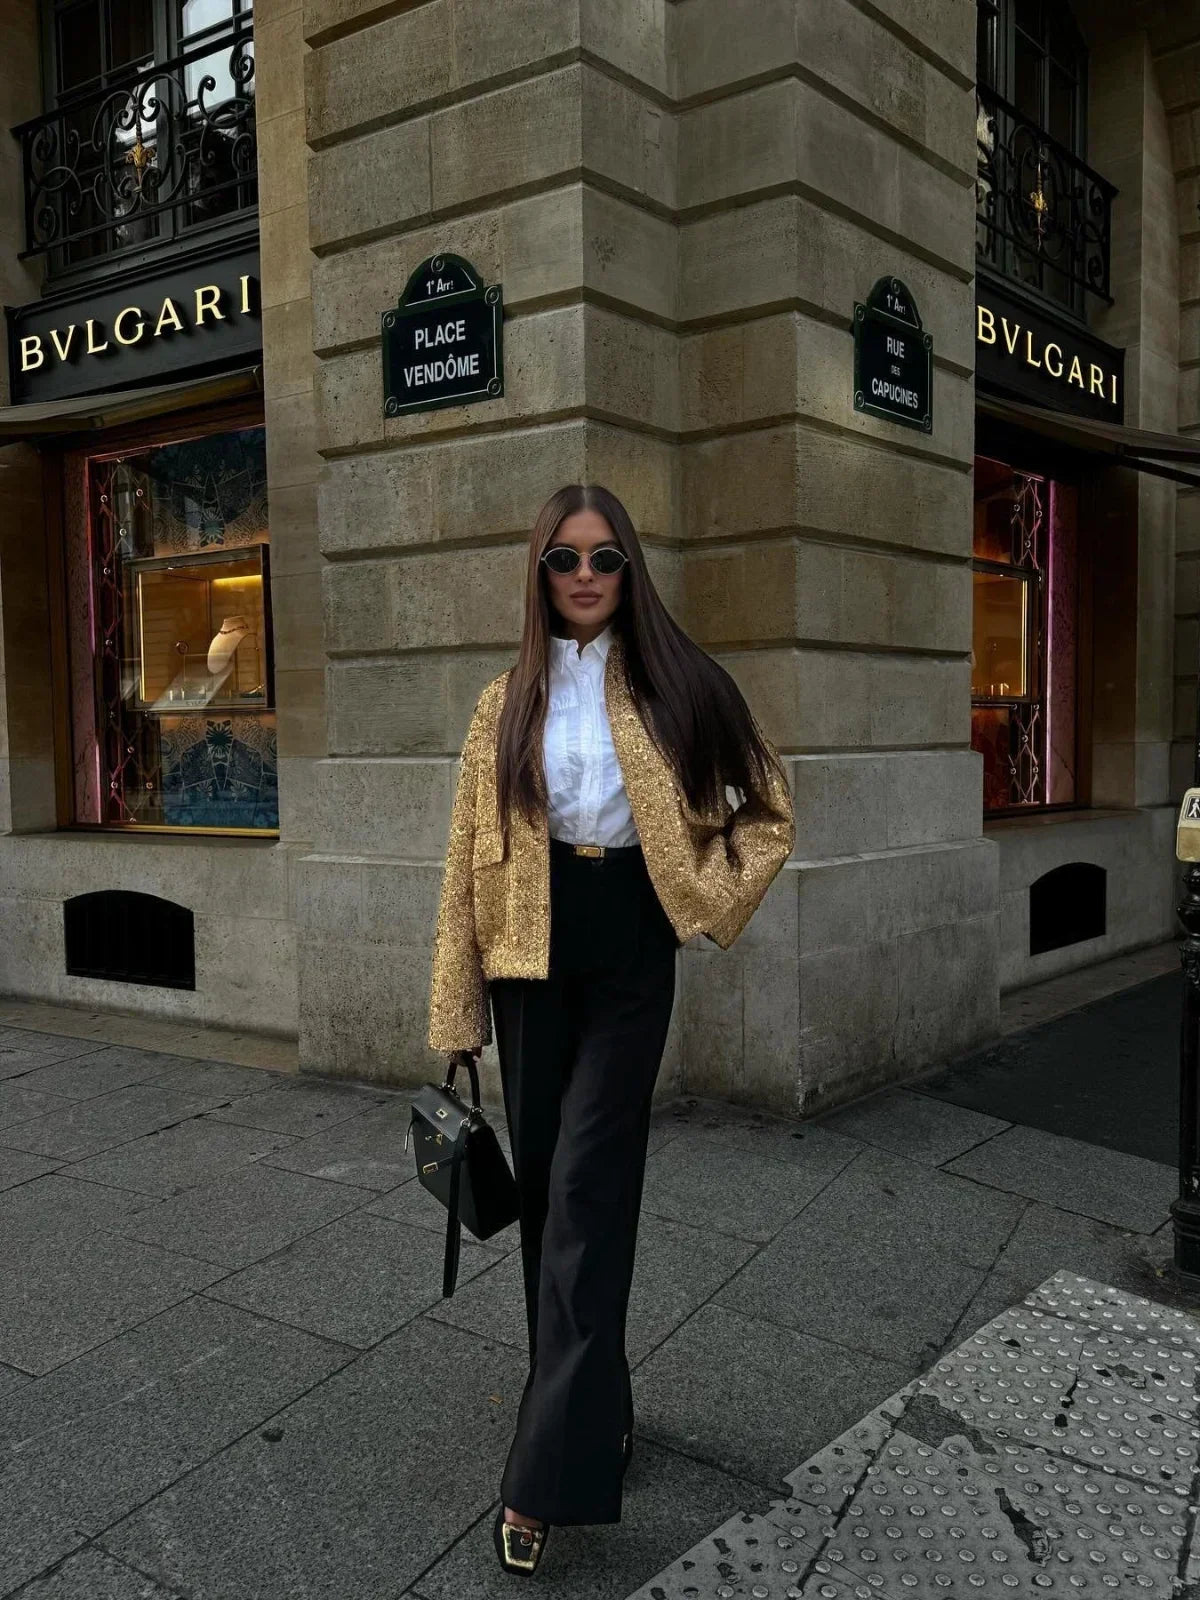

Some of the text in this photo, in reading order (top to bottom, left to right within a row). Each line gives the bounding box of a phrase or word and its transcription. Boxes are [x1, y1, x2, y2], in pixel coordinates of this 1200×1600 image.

[20, 275, 250, 371] BVLGARI
[415, 319, 466, 350] PLACE
[886, 336, 905, 359] RUE
[977, 305, 1117, 404] BVLGARI
[404, 353, 480, 388] VENDÔME
[871, 377, 918, 409] CAPUCINES
